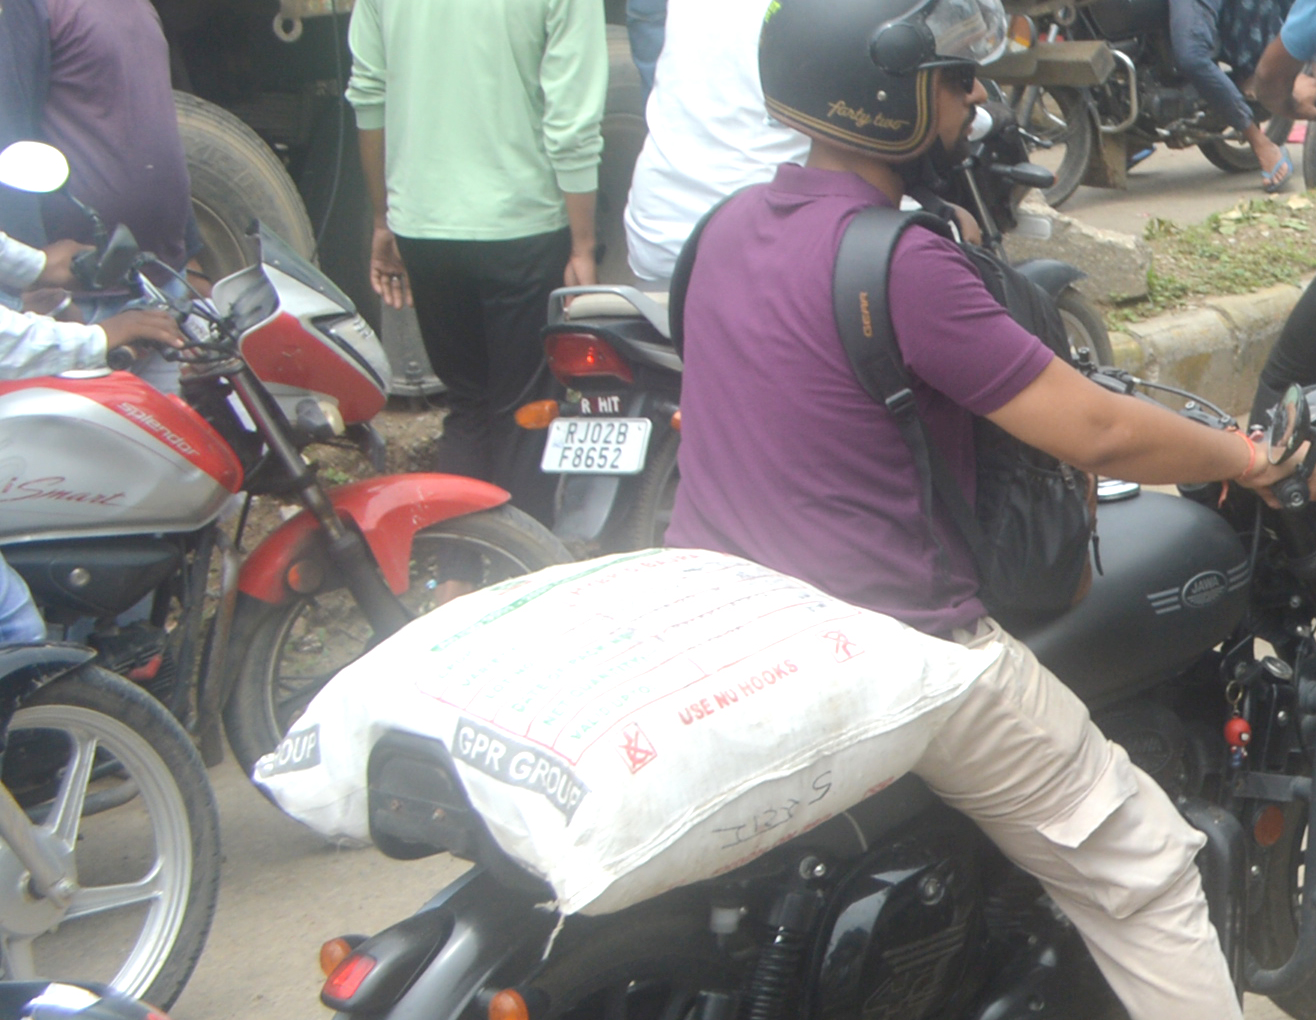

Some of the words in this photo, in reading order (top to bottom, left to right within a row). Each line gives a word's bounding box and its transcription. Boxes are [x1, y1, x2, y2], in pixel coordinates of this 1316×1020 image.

[565, 422, 629, 445] RJ02B
[558, 447, 622, 469] F8652
[1191, 575, 1219, 594] JAWA
[678, 698, 715, 725] USE
[737, 659, 798, 697] HOOKS
[459, 726, 507, 771] GPR
[509, 751, 581, 810] GROUP
